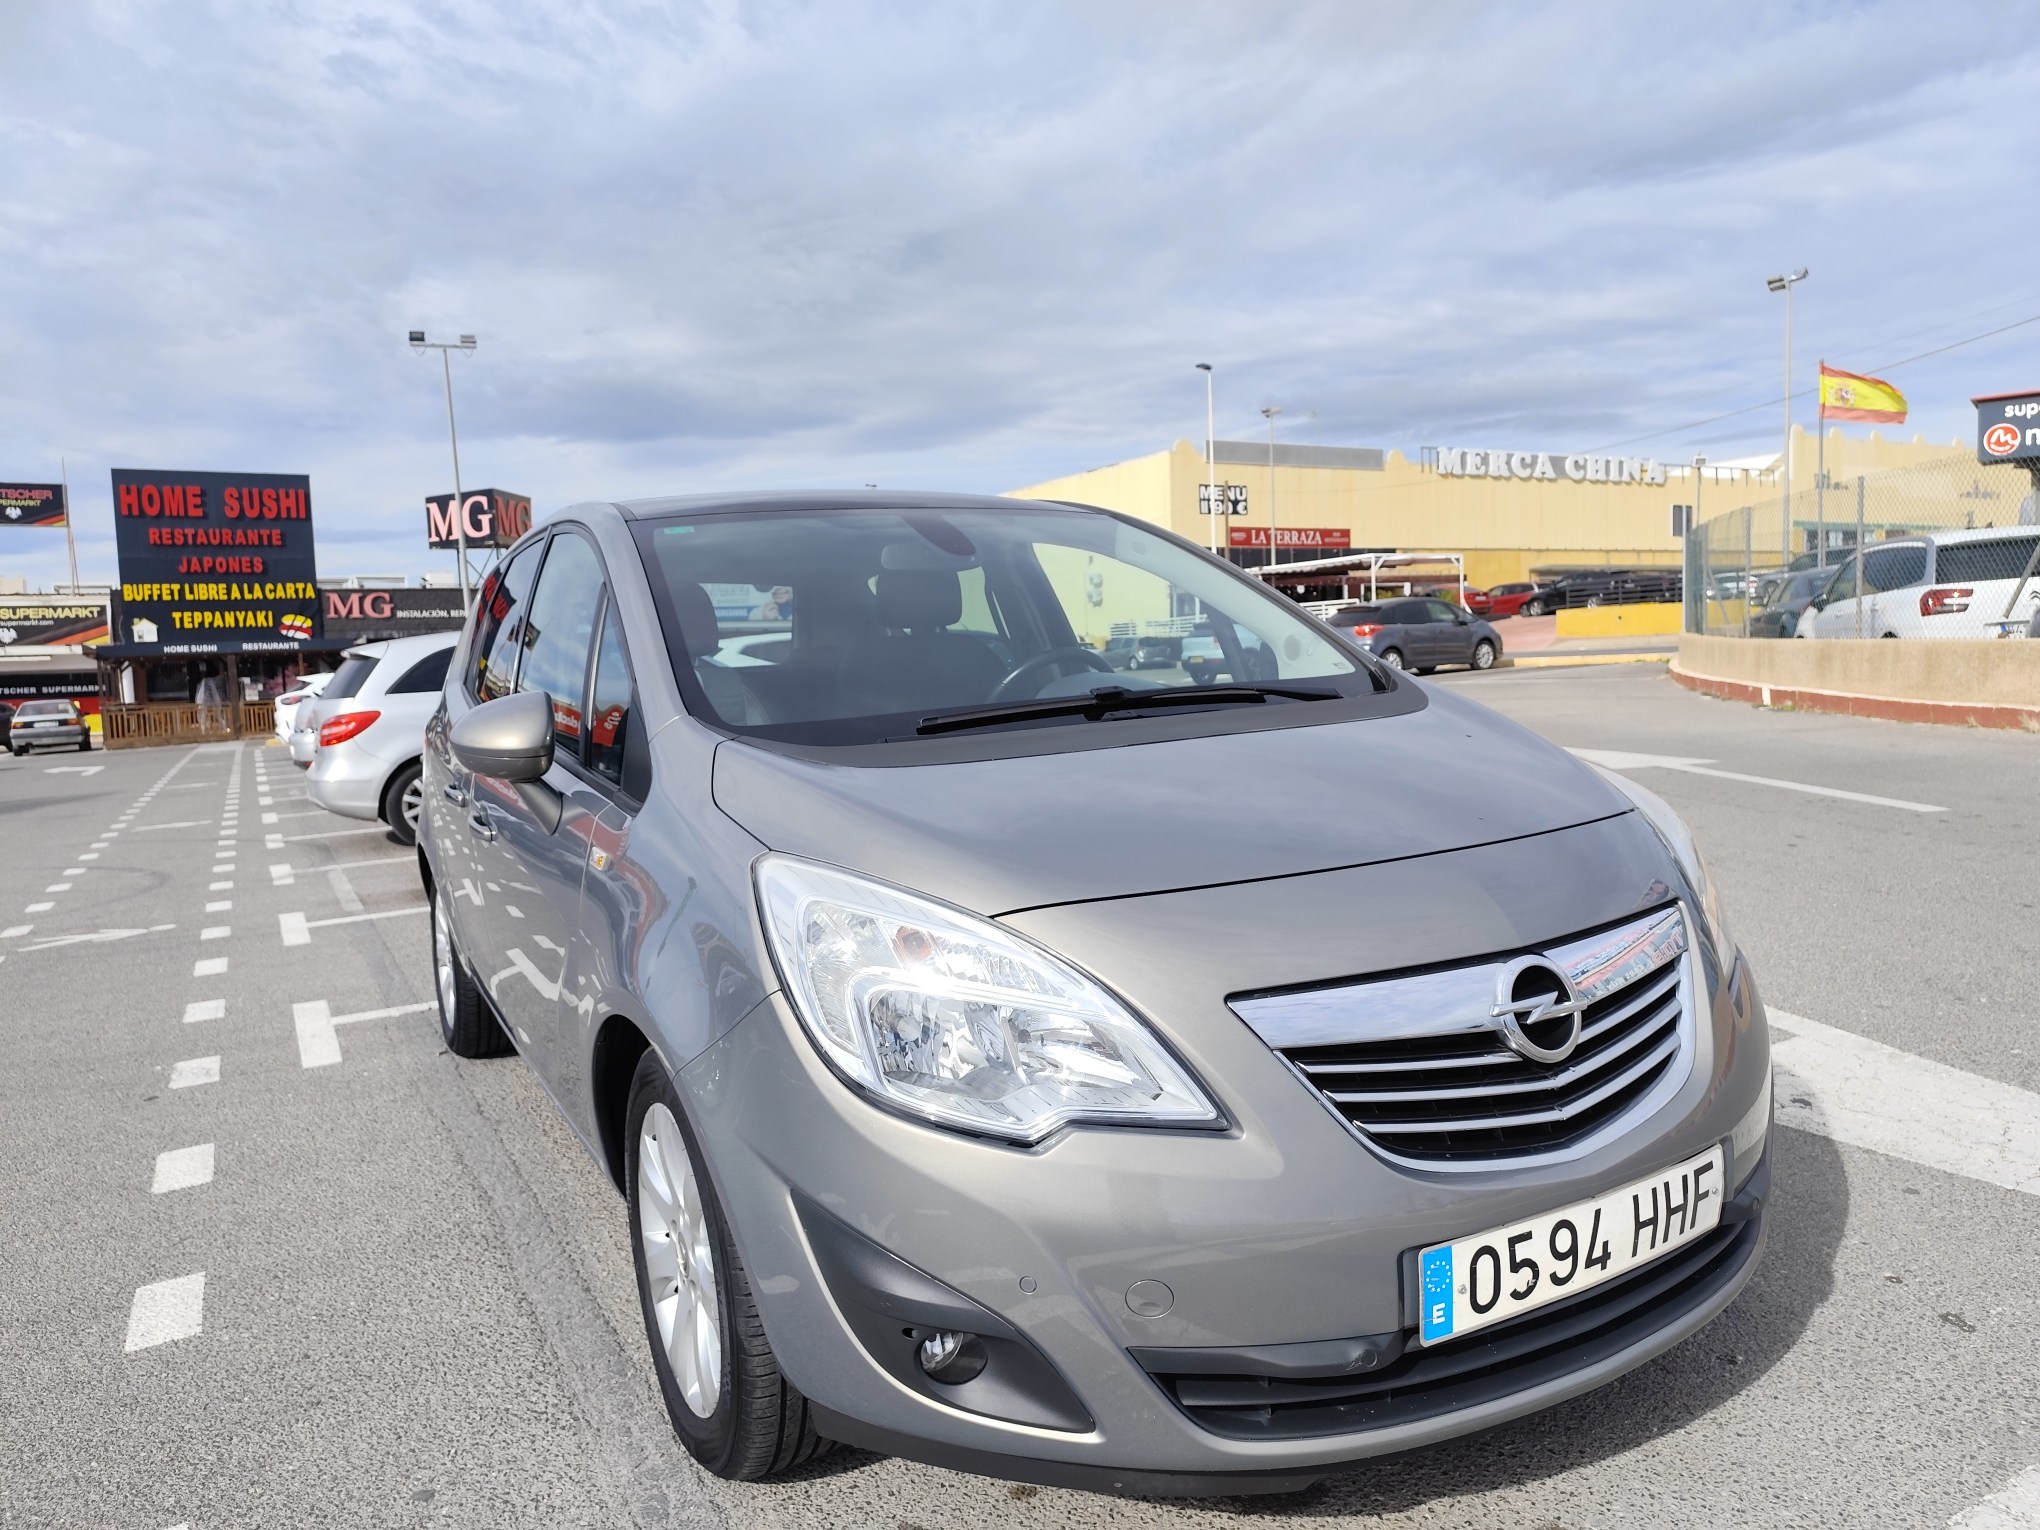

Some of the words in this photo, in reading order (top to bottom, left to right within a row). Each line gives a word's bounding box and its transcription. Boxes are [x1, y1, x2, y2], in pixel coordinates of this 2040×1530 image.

[2004, 403, 2040, 419] sup
[1437, 447, 1557, 480] MERCA
[1564, 454, 1666, 485] CHINA
[119, 484, 204, 517] HOME
[224, 486, 307, 519] SUSHI
[1236, 501, 1247, 515] €
[426, 495, 493, 542] MG
[495, 495, 532, 538] MG
[148, 527, 283, 546] RESTAURANTE
[1251, 529, 1267, 544] LA
[178, 556, 264, 573] JAPONES
[123, 583, 181, 602] BUFFET
[184, 582, 228, 601] LIBRE
[231, 582, 243, 600] A
[243, 582, 264, 600] LA
[264, 581, 316, 600] CARTA
[0, 607, 101, 619] SUPERMARKT
[326, 592, 394, 619] MG
[172, 610, 274, 629] TEPPANYAKI
[163, 645, 190, 654] HOME
[190, 644, 218, 653] SUSHI
[242, 642, 299, 651] RESTAURANTE
[1469, 1207, 1612, 1314] 0594
[1631, 1160, 1714, 1258] HHF
[1432, 1302, 1446, 1325] E
